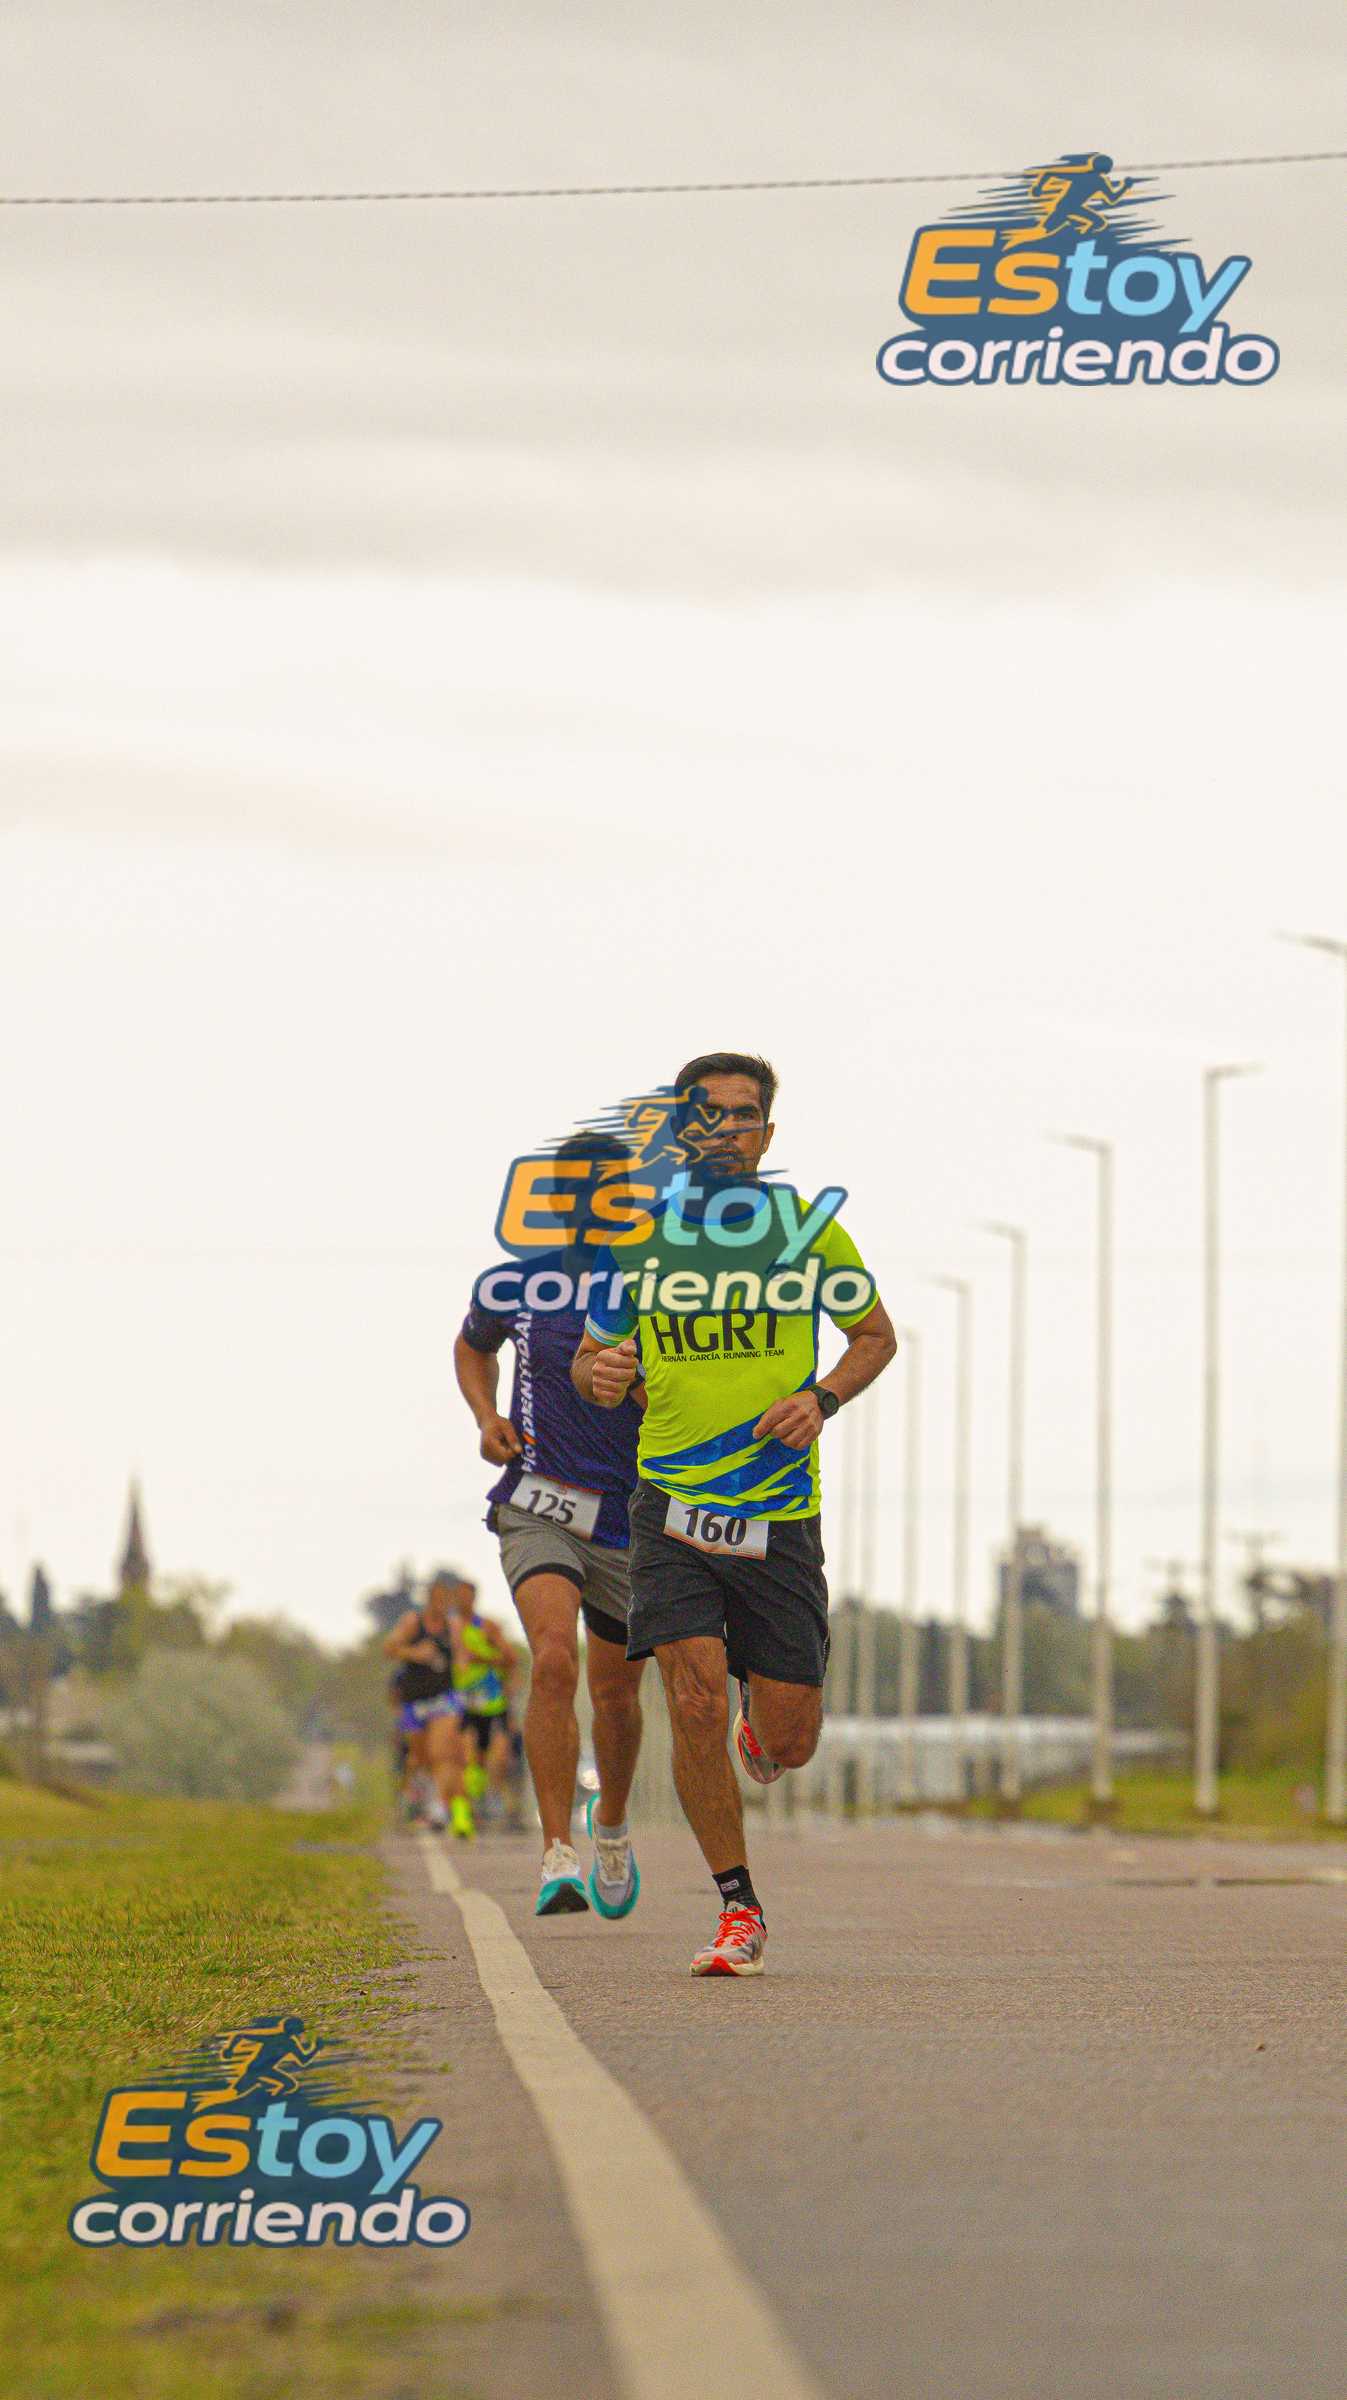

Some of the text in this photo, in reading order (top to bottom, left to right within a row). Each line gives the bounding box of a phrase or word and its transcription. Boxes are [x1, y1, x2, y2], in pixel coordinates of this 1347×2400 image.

[650, 1308, 778, 1354] HGRT
[723, 1350, 761, 1360] RUNNING
[765, 1348, 785, 1357] TEAM
[526, 1489, 577, 1526] 125
[684, 1508, 747, 1546] 160
